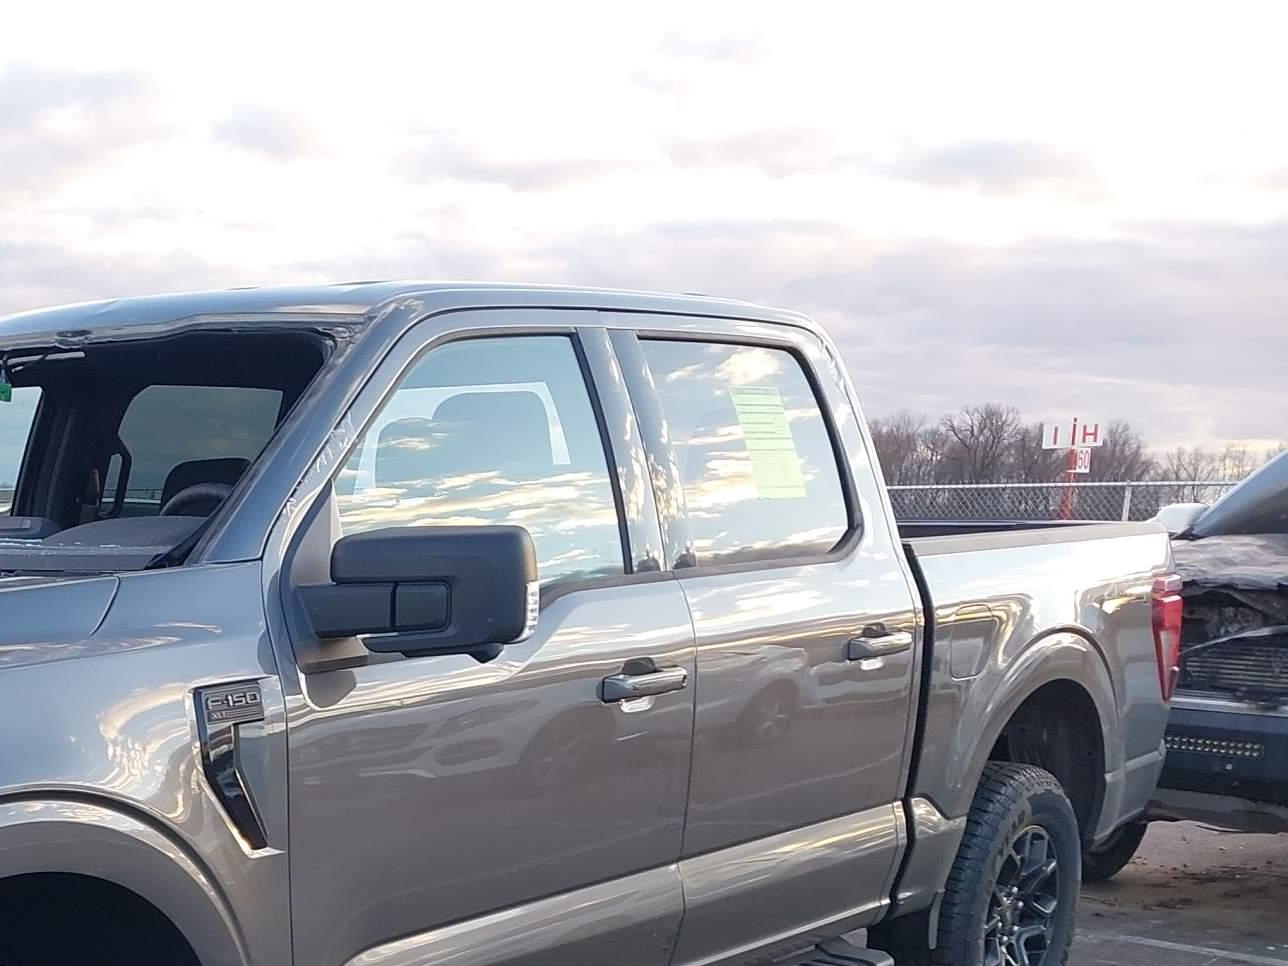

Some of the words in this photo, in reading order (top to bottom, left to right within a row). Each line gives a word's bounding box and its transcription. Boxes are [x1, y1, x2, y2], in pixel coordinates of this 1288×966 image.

[1081, 423, 1099, 443] H
[1078, 450, 1090, 469] 60
[207, 691, 261, 710] F-150
